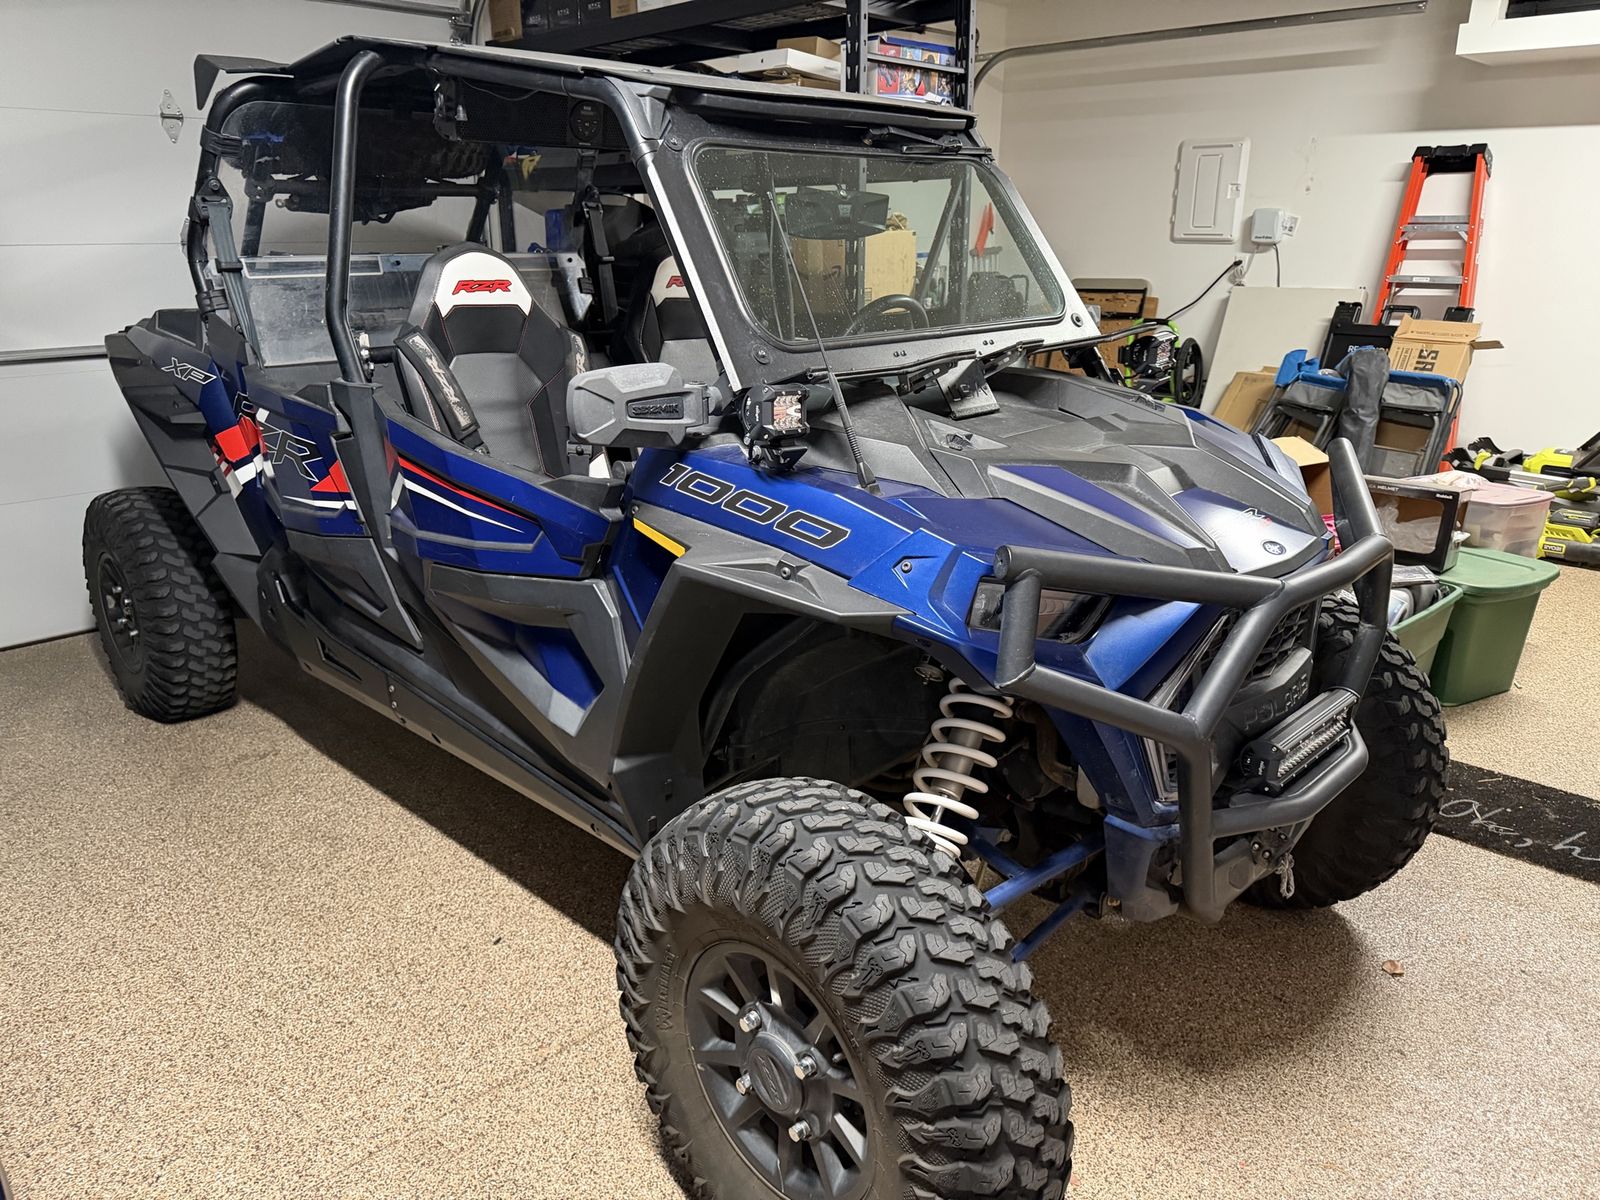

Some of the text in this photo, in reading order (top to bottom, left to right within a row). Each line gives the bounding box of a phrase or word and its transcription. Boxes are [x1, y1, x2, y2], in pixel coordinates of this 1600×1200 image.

[452, 279, 512, 295] RZR
[161, 357, 217, 384] XP
[659, 462, 851, 549] 1000
[1543, 544, 1562, 552] RYOBI
[1243, 673, 1308, 731] POLARIS
